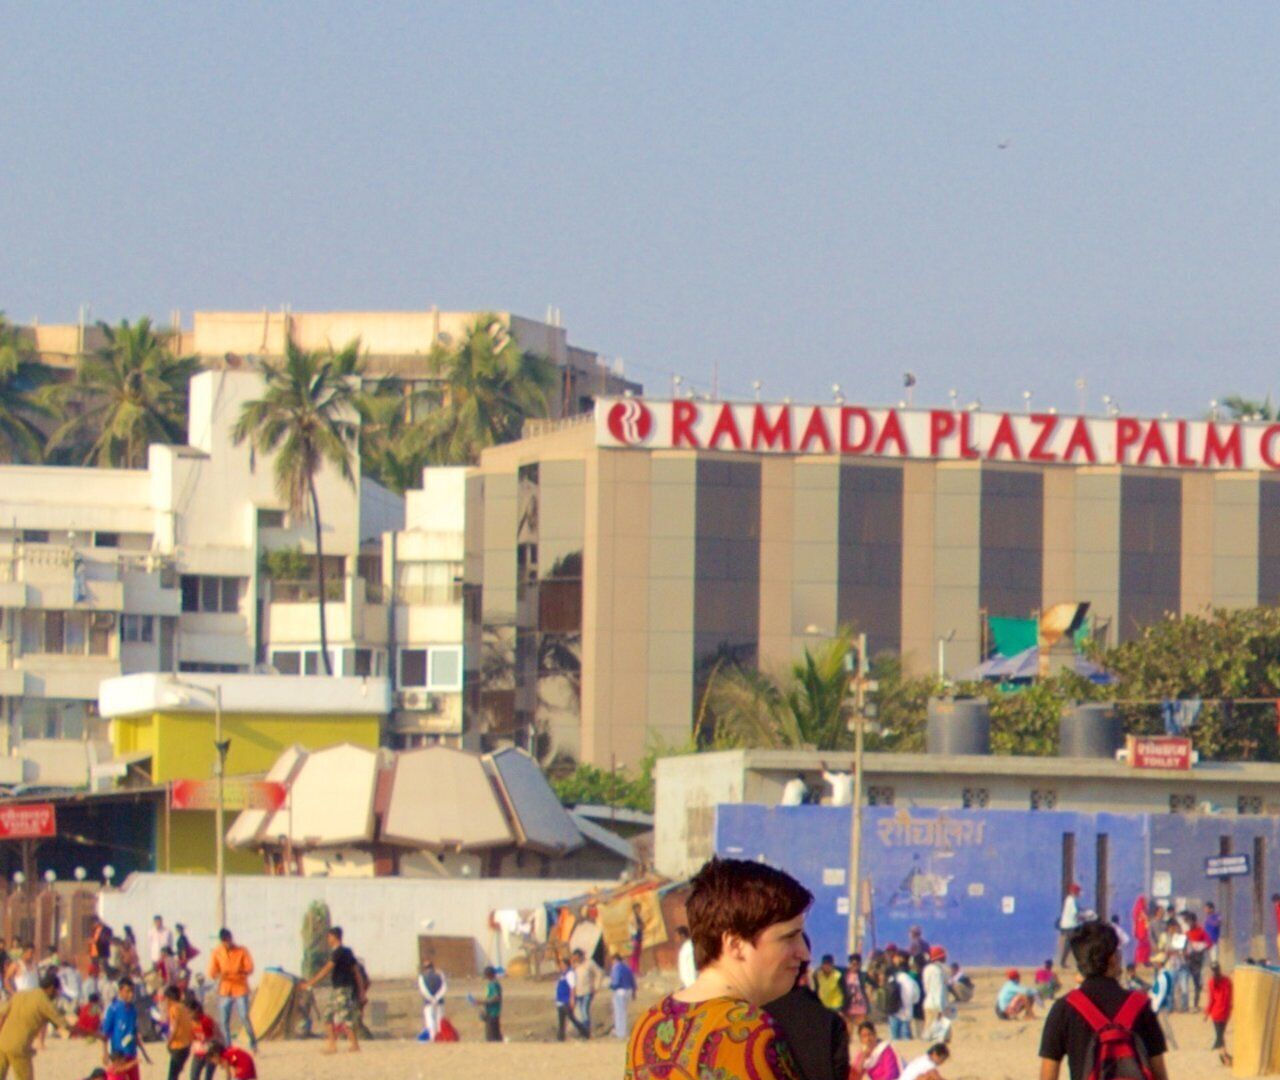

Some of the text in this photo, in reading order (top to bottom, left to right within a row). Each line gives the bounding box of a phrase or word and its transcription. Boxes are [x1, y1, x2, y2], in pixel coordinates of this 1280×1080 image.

[672, 400, 907, 456] RAMADA
[930, 410, 1097, 463] PLAZA
[1116, 417, 1243, 470] PALM
[1143, 757, 1180, 767] TOILET
